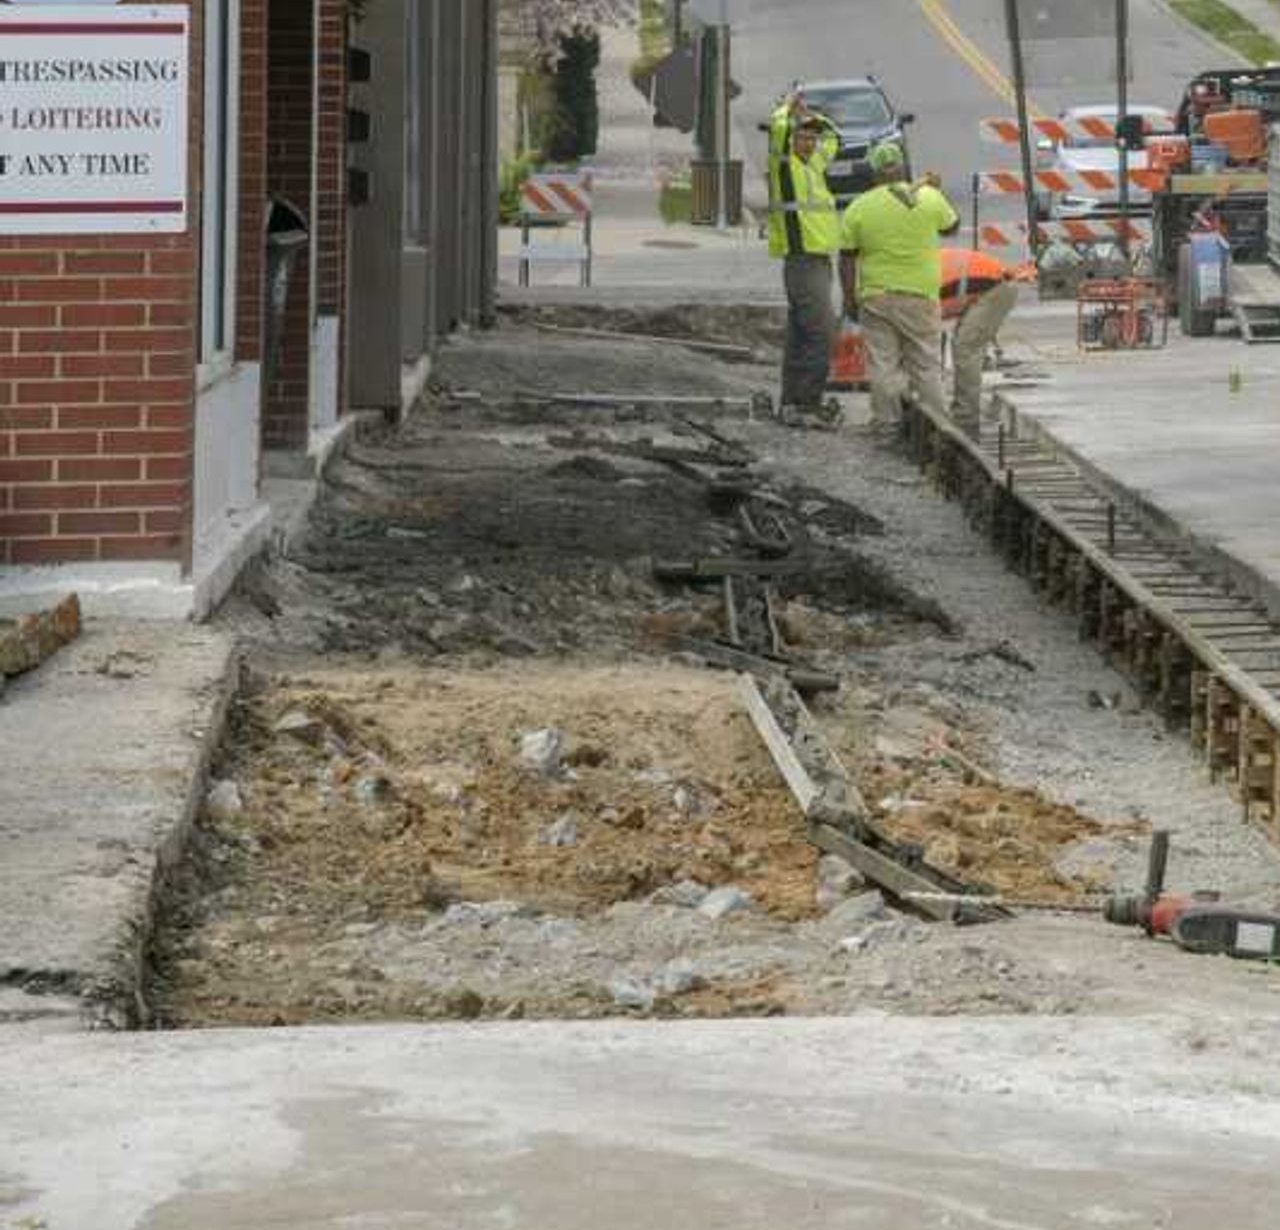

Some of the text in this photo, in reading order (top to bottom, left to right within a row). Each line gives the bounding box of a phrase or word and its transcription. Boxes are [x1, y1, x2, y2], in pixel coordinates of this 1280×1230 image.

[0, 59, 178, 82] TRESPASSING
[12, 107, 162, 130] LOITERING
[19, 154, 74, 175] ANY
[80, 154, 150, 175] TIME
